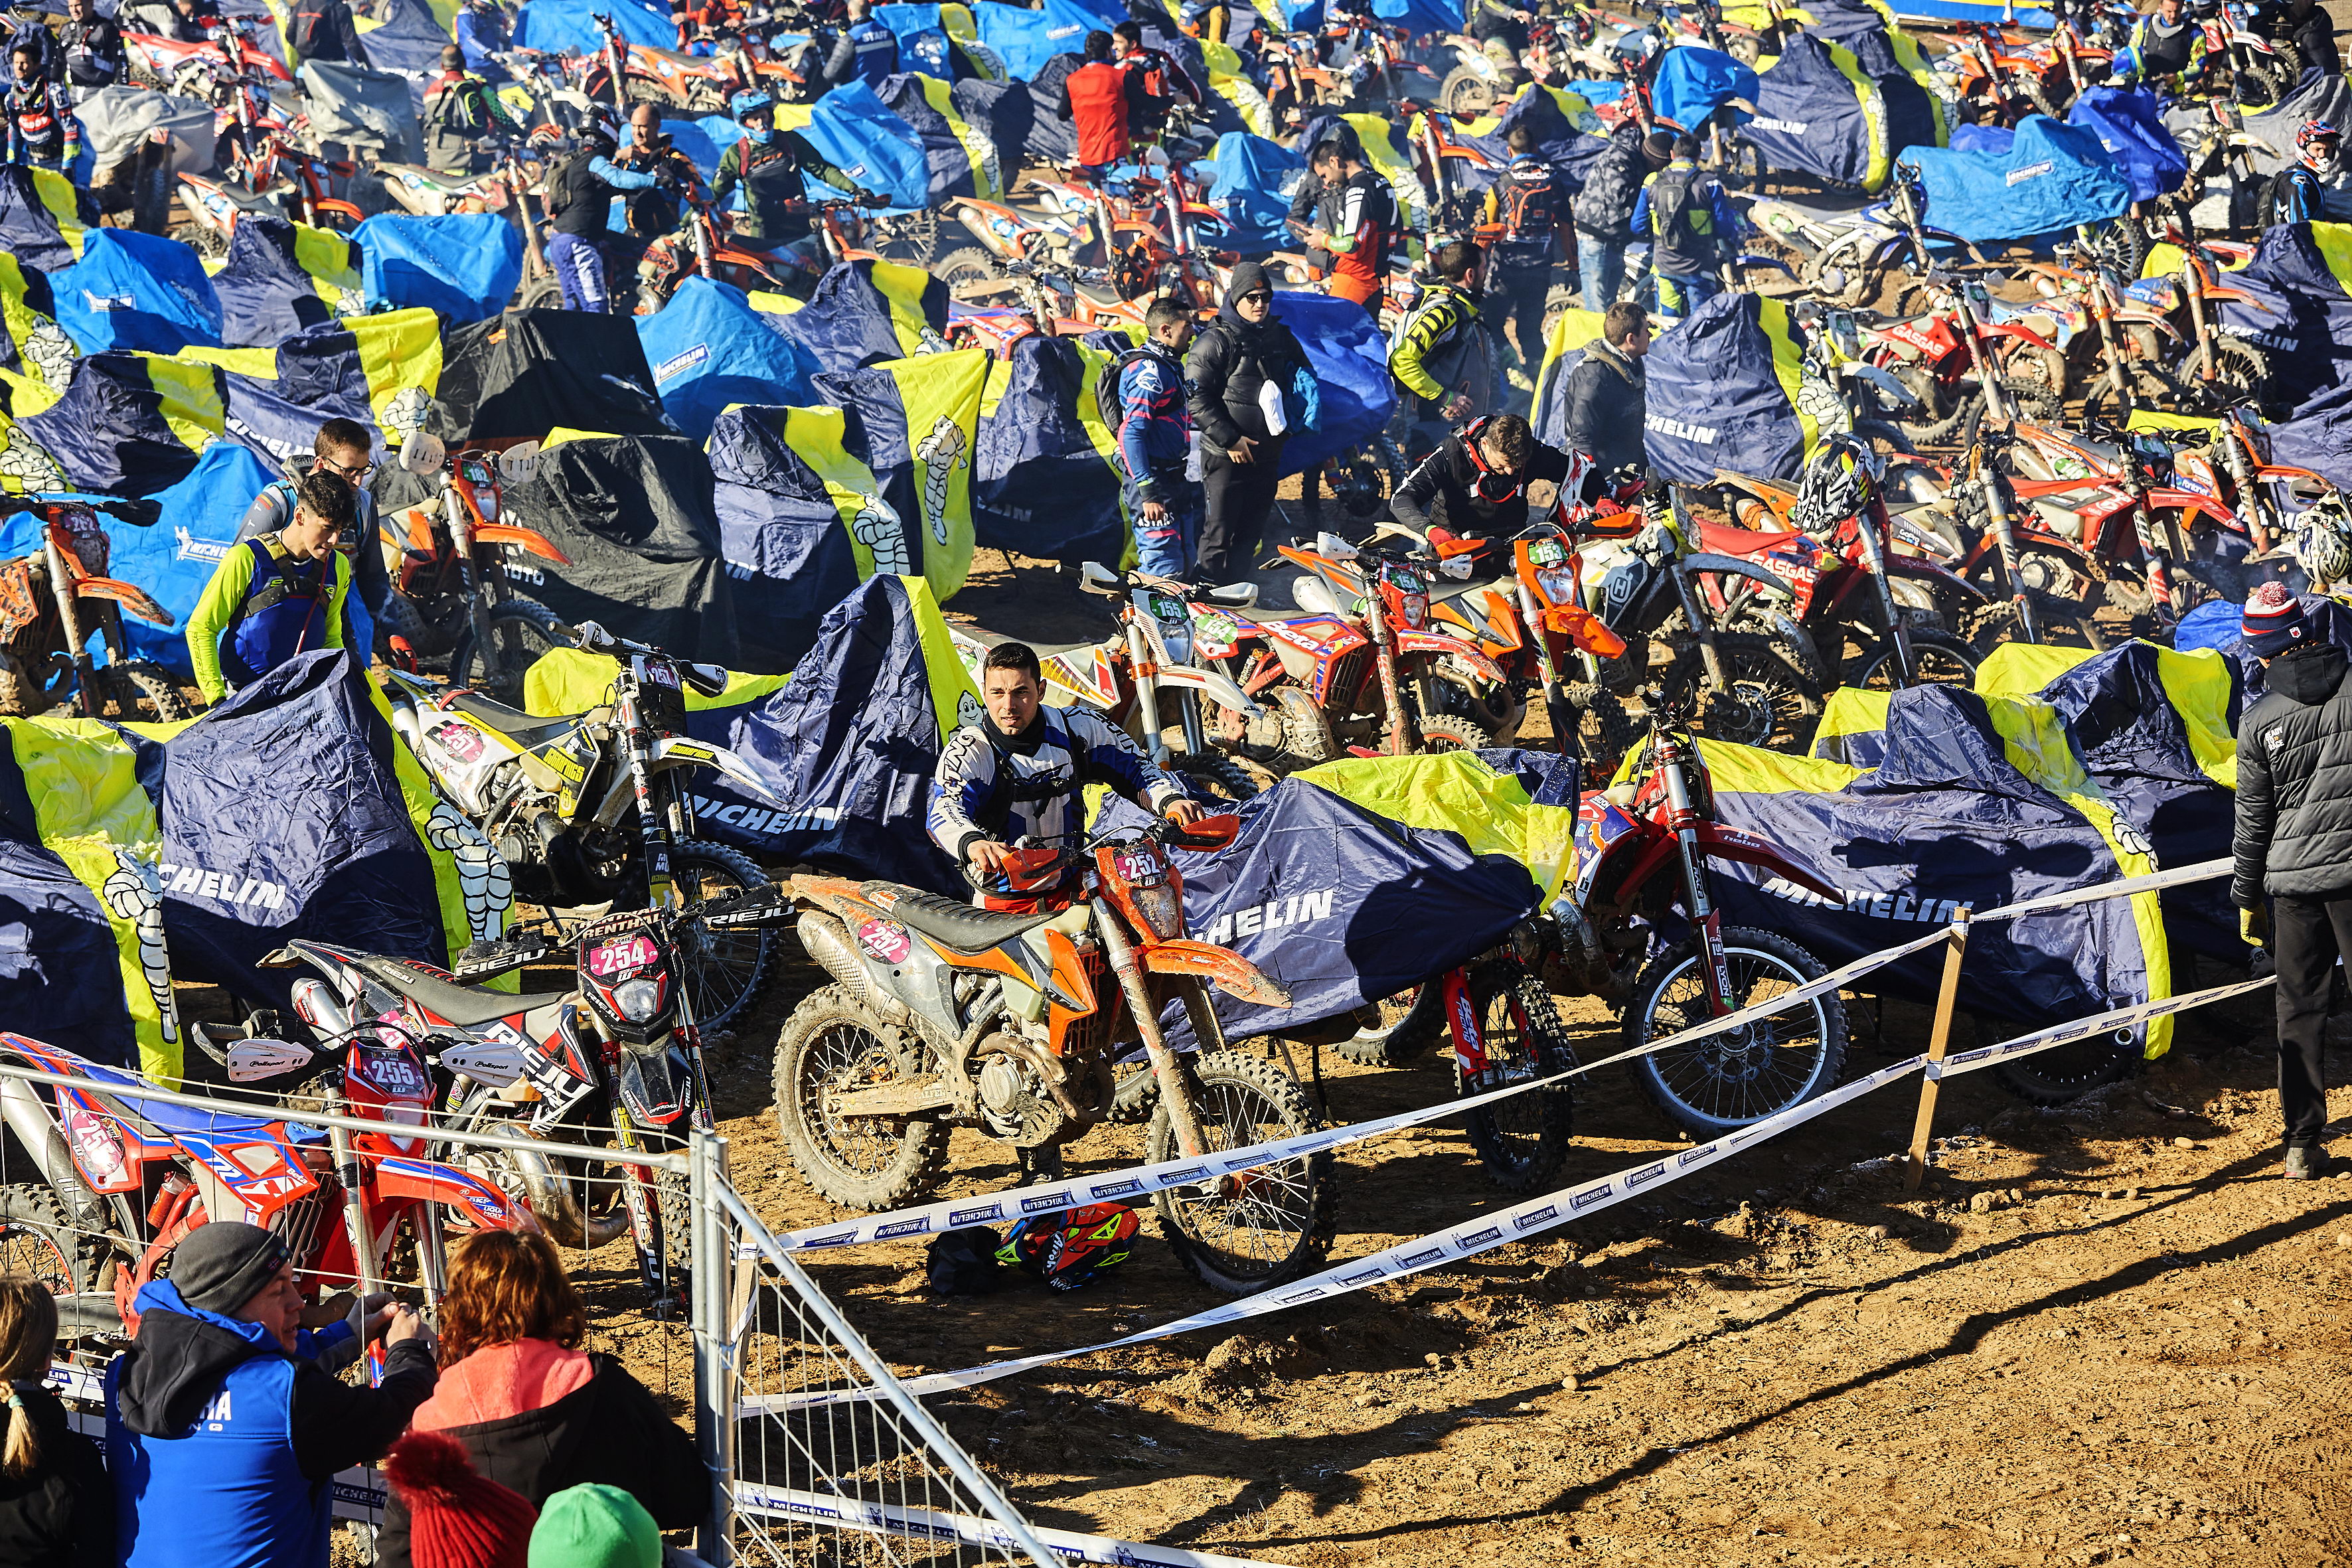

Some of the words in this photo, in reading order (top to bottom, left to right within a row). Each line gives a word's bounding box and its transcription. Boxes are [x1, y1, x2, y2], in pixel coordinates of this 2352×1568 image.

[862, 31, 888, 42] STAFF
[1891, 325, 1945, 356] GASGAS
[661, 345, 706, 377] MICHELIN
[469, 466, 489, 482] 182
[1535, 544, 1563, 564] 153
[1747, 554, 1820, 584] GASGAS
[1397, 574, 1419, 590] 154
[1158, 601, 1182, 619] 155
[1204, 620, 1229, 639] 154
[1258, 621, 1320, 651] Beta
[1406, 641, 1441, 649] Polisport
[651, 667, 673, 686] 257
[447, 729, 477, 755] 257
[682, 791, 845, 835] MICHELIN
[1723, 834, 1761, 848] hebo
[1125, 854, 1160, 880] 252
[706, 905, 795, 925] RIEJU
[1196, 889, 1334, 945] HELIN
[582, 913, 663, 939] RENTHAL
[863, 926, 903, 957] 252
[456, 948, 546, 977] RIEJU
[600, 941, 647, 975] 254
[381, 965, 417, 985] RIEJU
[1719, 965, 1730, 996] LYON
[586, 990, 621, 1022] RIEJU
[1456, 998, 1470, 1042] racing
[1459, 996, 1480, 1051] Beta
[250, 1059, 285, 1068] Polisport
[474, 1059, 509, 1070] Polisport
[483, 1021, 595, 1099] RIEJU
[371, 1059, 416, 1085] 255
[623, 1089, 643, 1119] RIEJU
[1684, 1144, 1716, 1162] MICHELIN
[287, 1167, 309, 1185] Beta
[1160, 1168, 1201, 1183] MICHELIN
[1632, 1164, 1663, 1182] MICHELIN
[1093, 1182, 1133, 1198] MICHELIN
[1578, 1186, 1609, 1204] MICHELIN
[1024, 1197, 1063, 1211] MICHELIN
[951, 1210, 993, 1224] MICHELIN
[1522, 1208, 1554, 1226] MICHELIN
[876, 1221, 919, 1238] MICHELIN
[1465, 1230, 1498, 1247] MICHELIN
[1046, 1233, 1064, 1273] Airoh
[1407, 1249, 1441, 1267] MICHELIN
[1346, 1269, 1382, 1286] MICHELIN
[48, 1370, 68, 1381] LIN
[773, 1502, 839, 1518] MICHELIN
